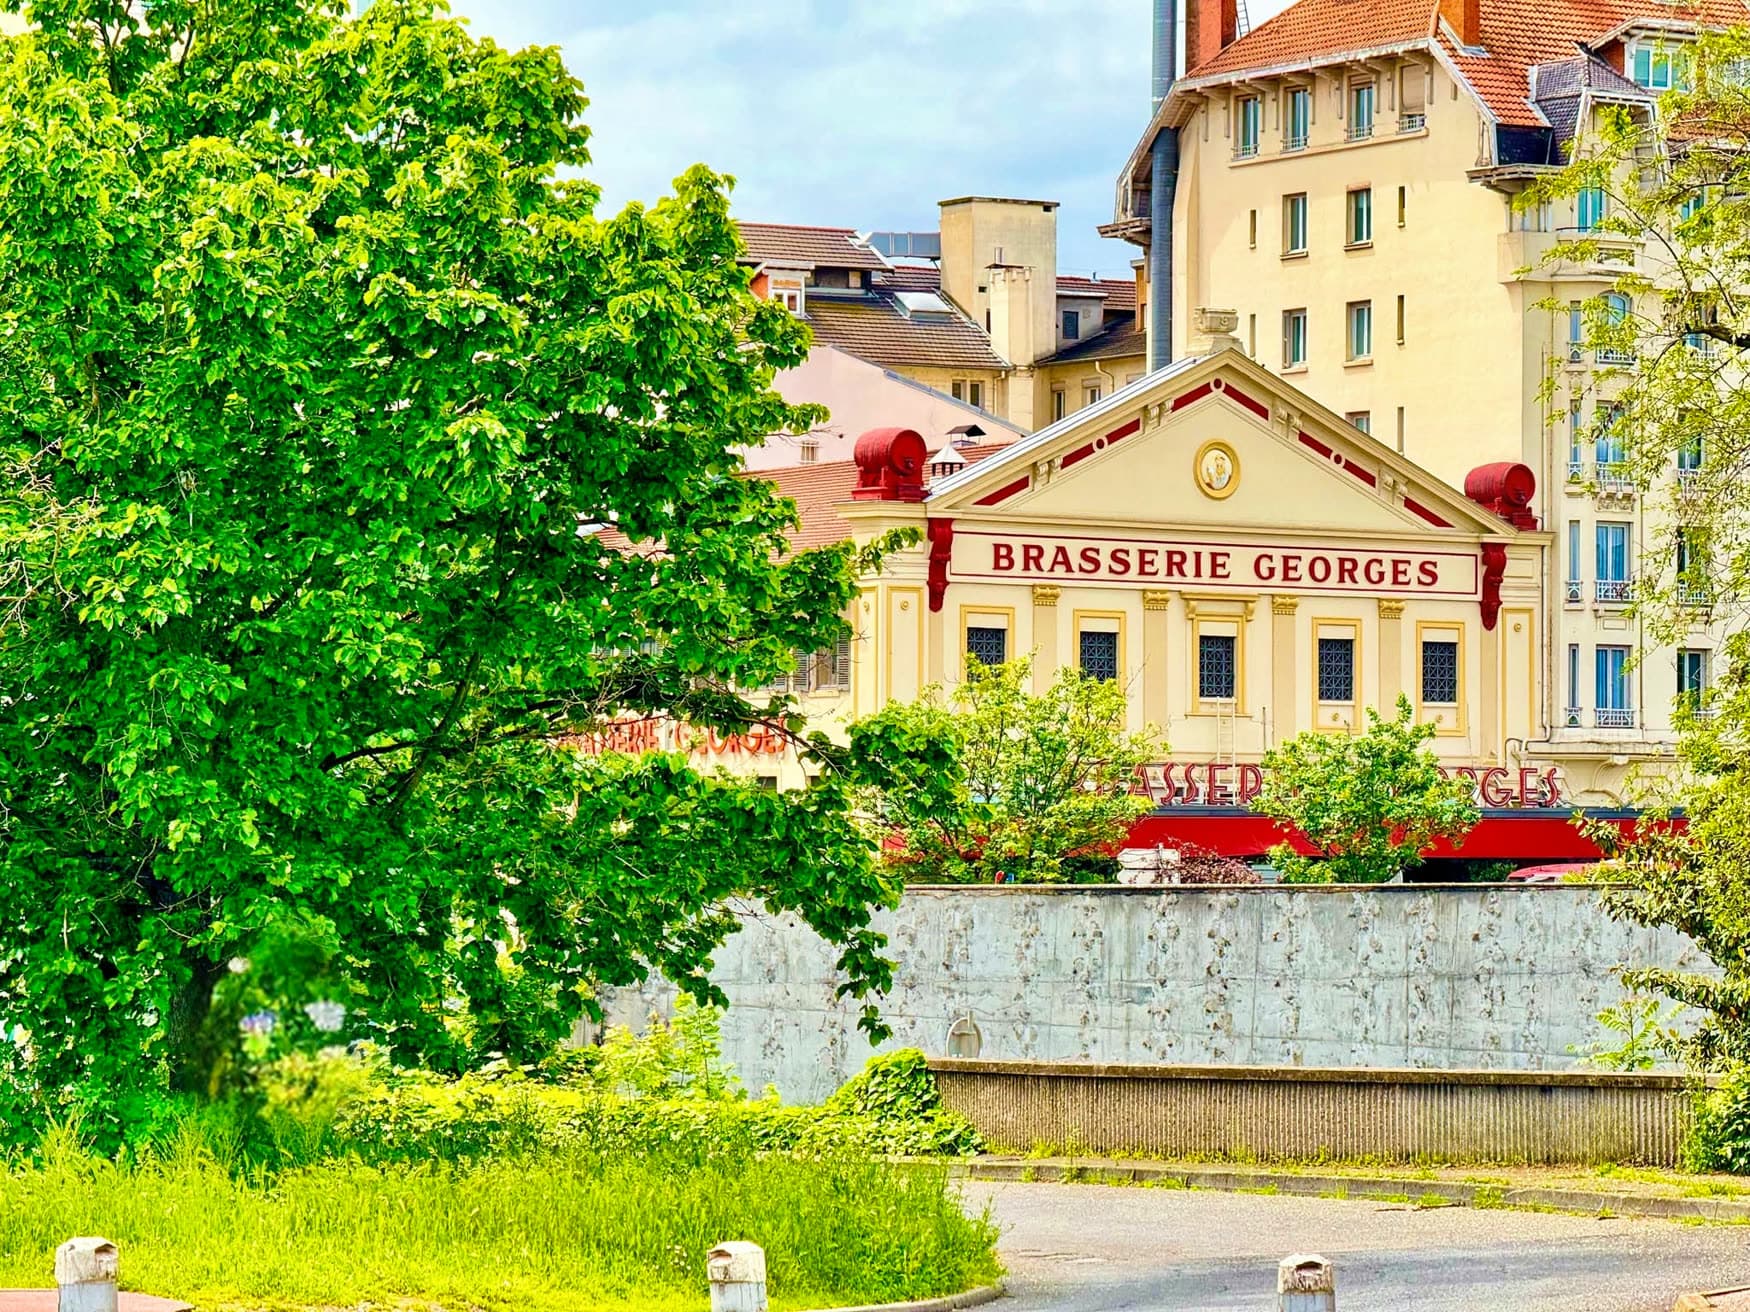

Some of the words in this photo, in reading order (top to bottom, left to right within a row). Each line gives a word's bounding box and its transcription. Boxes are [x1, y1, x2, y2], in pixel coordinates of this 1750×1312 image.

[992, 543, 1231, 579] BRASSERIE
[1253, 553, 1439, 587] GEORGES
[1074, 761, 1265, 806] ASSER
[1436, 766, 1559, 807] RGES
